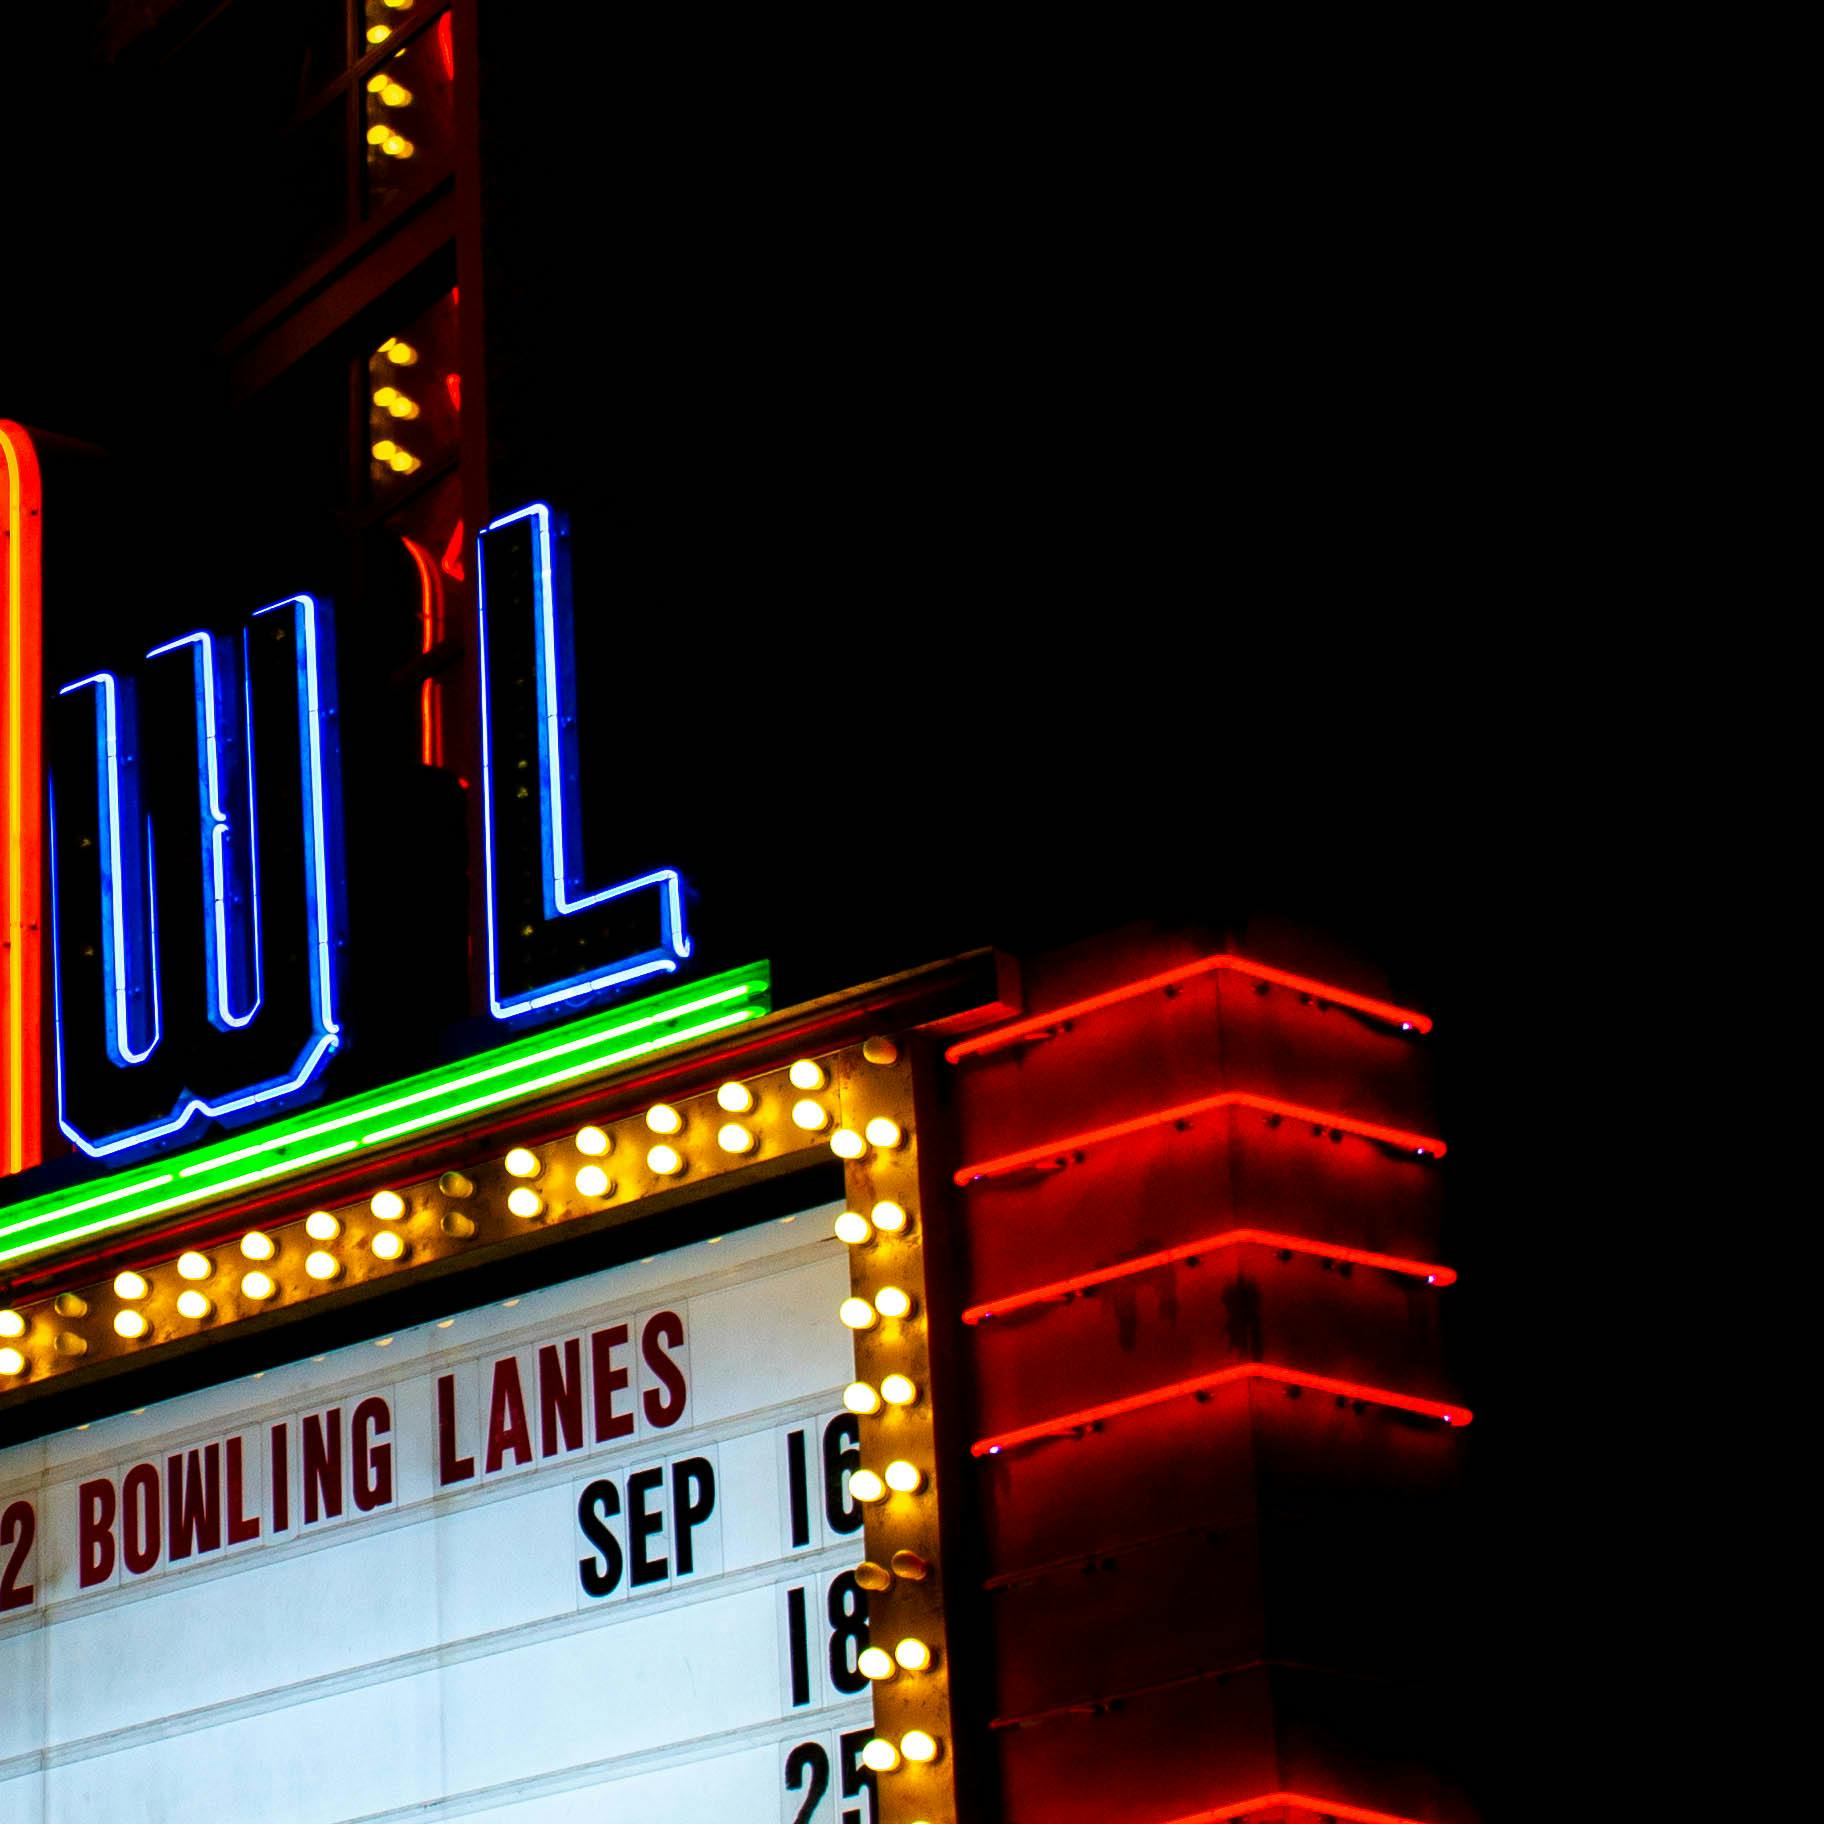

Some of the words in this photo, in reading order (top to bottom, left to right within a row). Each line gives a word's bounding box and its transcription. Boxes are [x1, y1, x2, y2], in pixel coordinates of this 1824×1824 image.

[78, 1395, 394, 1589] BOWLING
[436, 1310, 687, 1486] LANES
[578, 1456, 716, 1598] SEP
[787, 1412, 864, 1548] 16
[787, 1570, 872, 1707] 18
